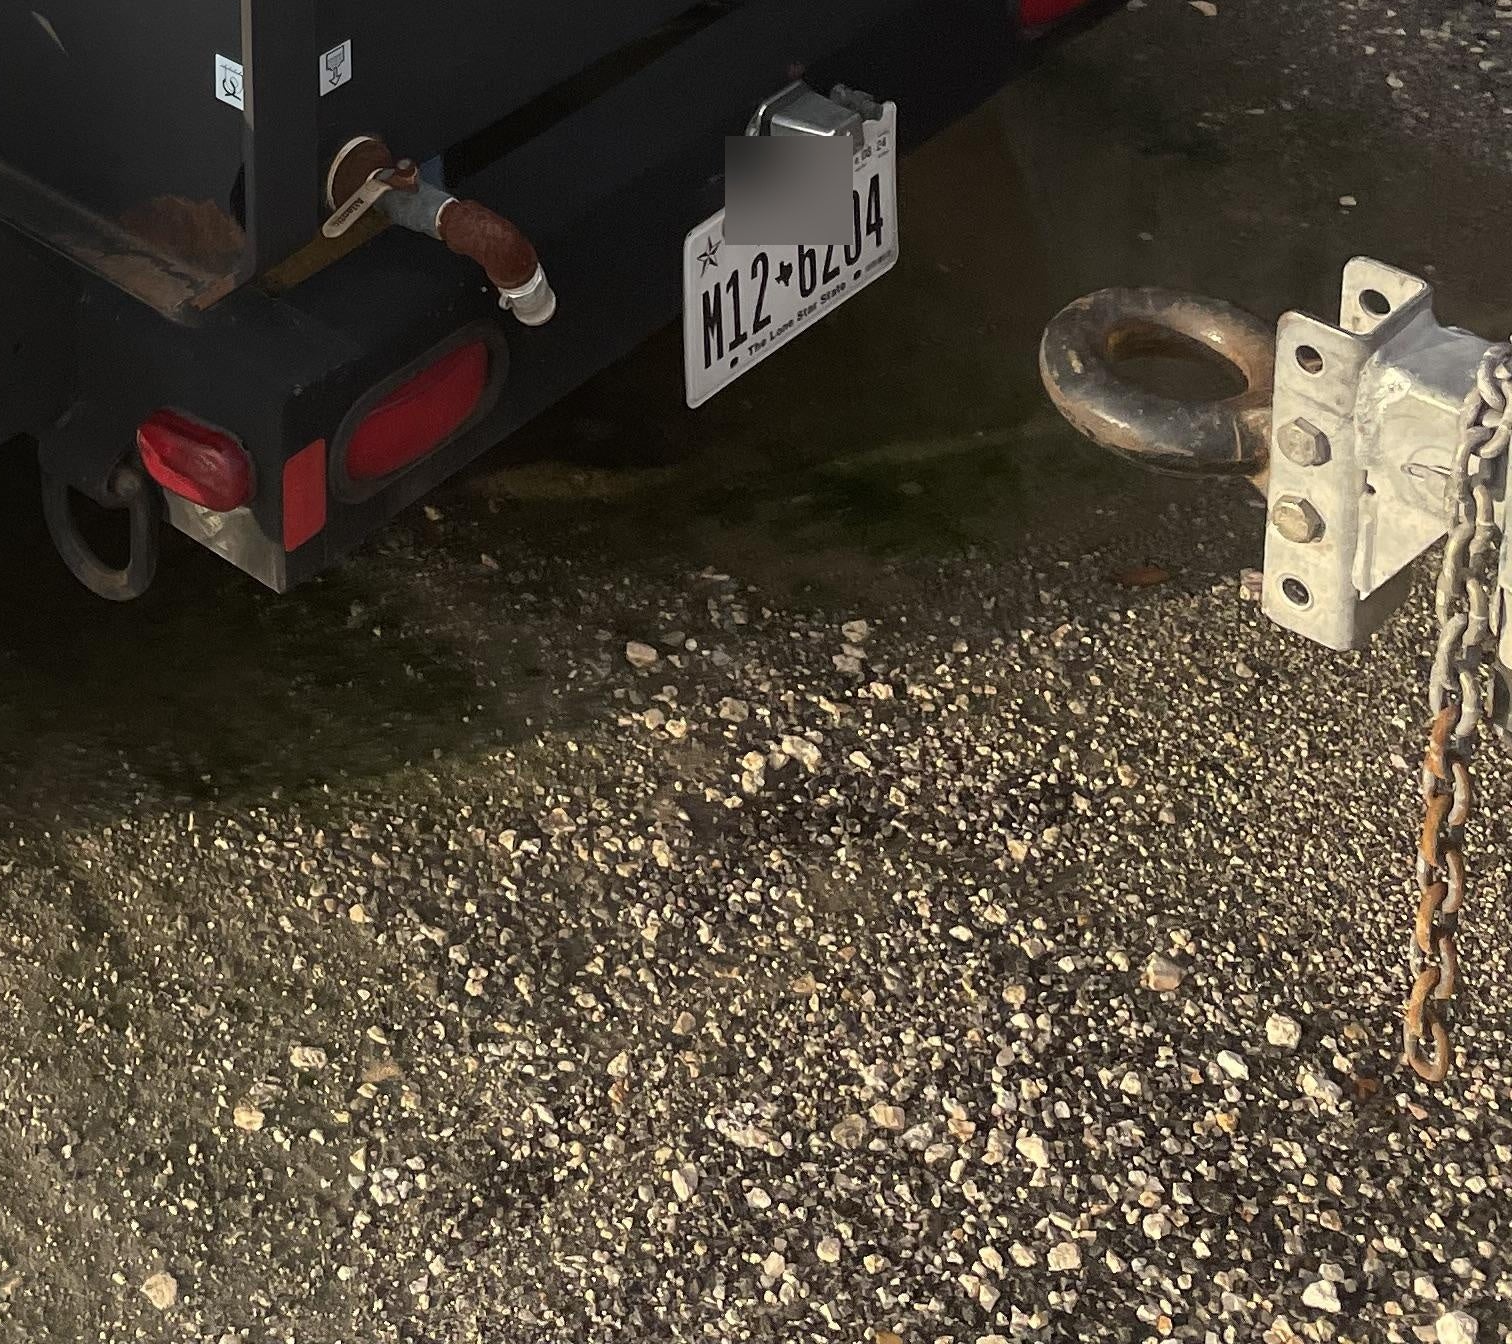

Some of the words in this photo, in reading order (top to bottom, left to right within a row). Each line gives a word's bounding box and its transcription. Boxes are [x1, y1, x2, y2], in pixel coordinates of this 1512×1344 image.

[701, 251, 772, 370] M12
[747, 337, 768, 357] The
[769, 318, 795, 342] Lone
[796, 300, 819, 322] Star
[820, 281, 847, 305] State
